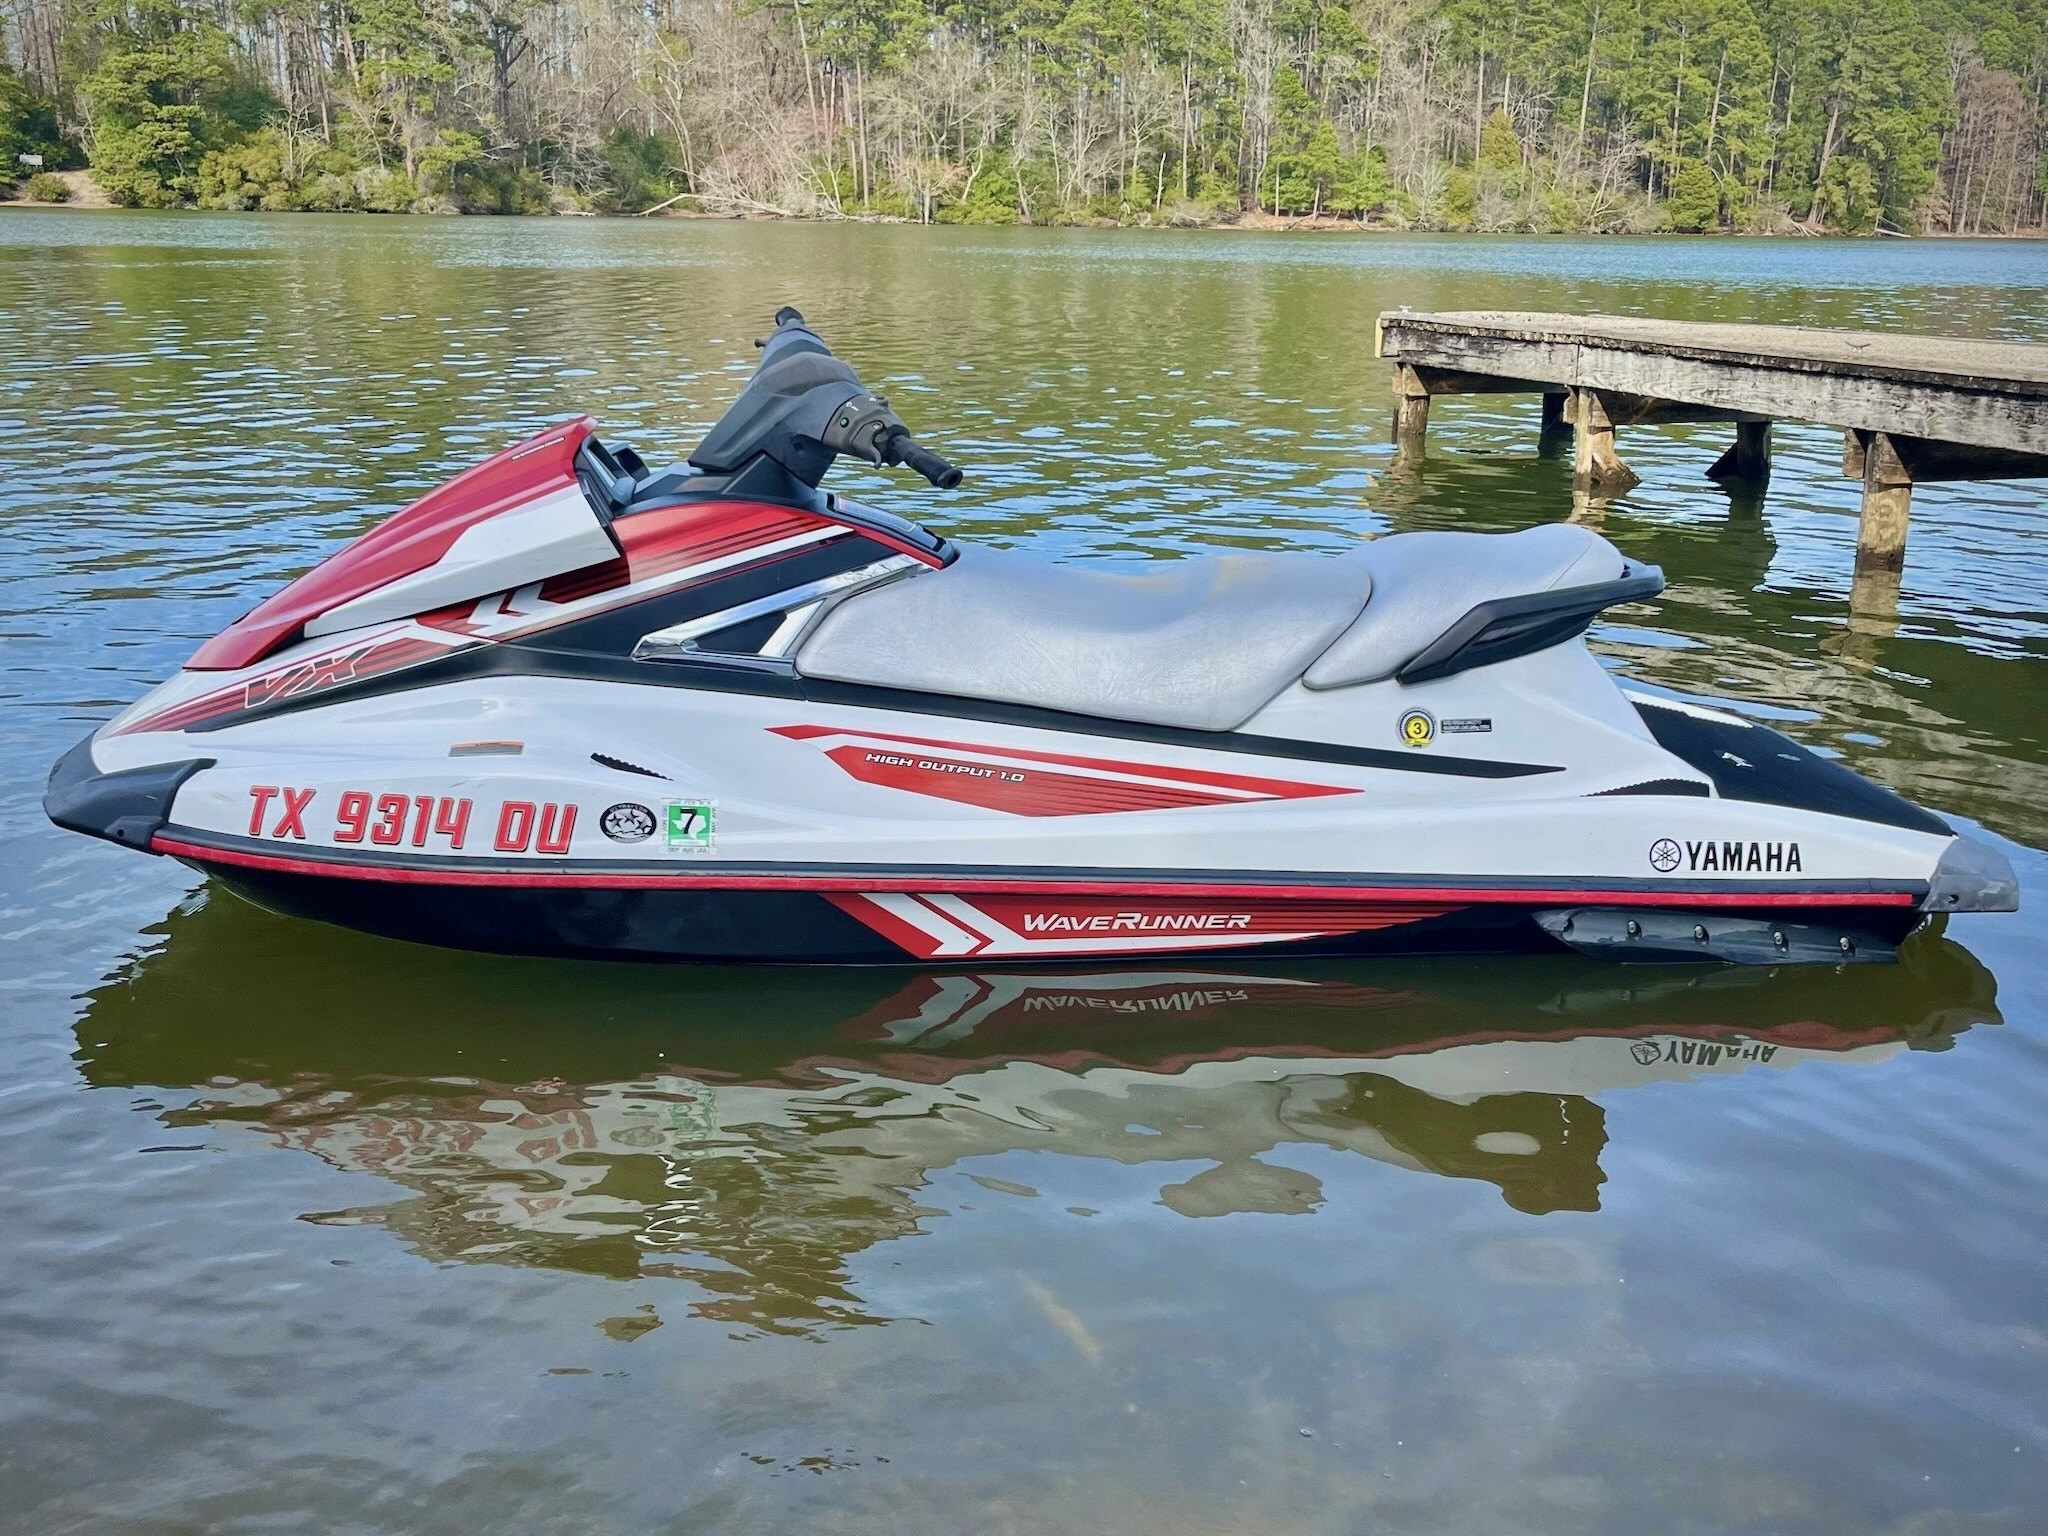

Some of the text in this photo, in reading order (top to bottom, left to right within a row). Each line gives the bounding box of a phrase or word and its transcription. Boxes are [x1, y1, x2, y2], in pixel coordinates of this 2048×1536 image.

[245, 644, 380, 709] VX
[1413, 722, 1422, 735] 3
[865, 753, 1025, 782] HIGH OUTPUT 1.0
[248, 785, 316, 839] TX
[333, 791, 473, 850] 9314
[680, 808, 698, 834] 7
[1686, 841, 1802, 872] YAMAHA
